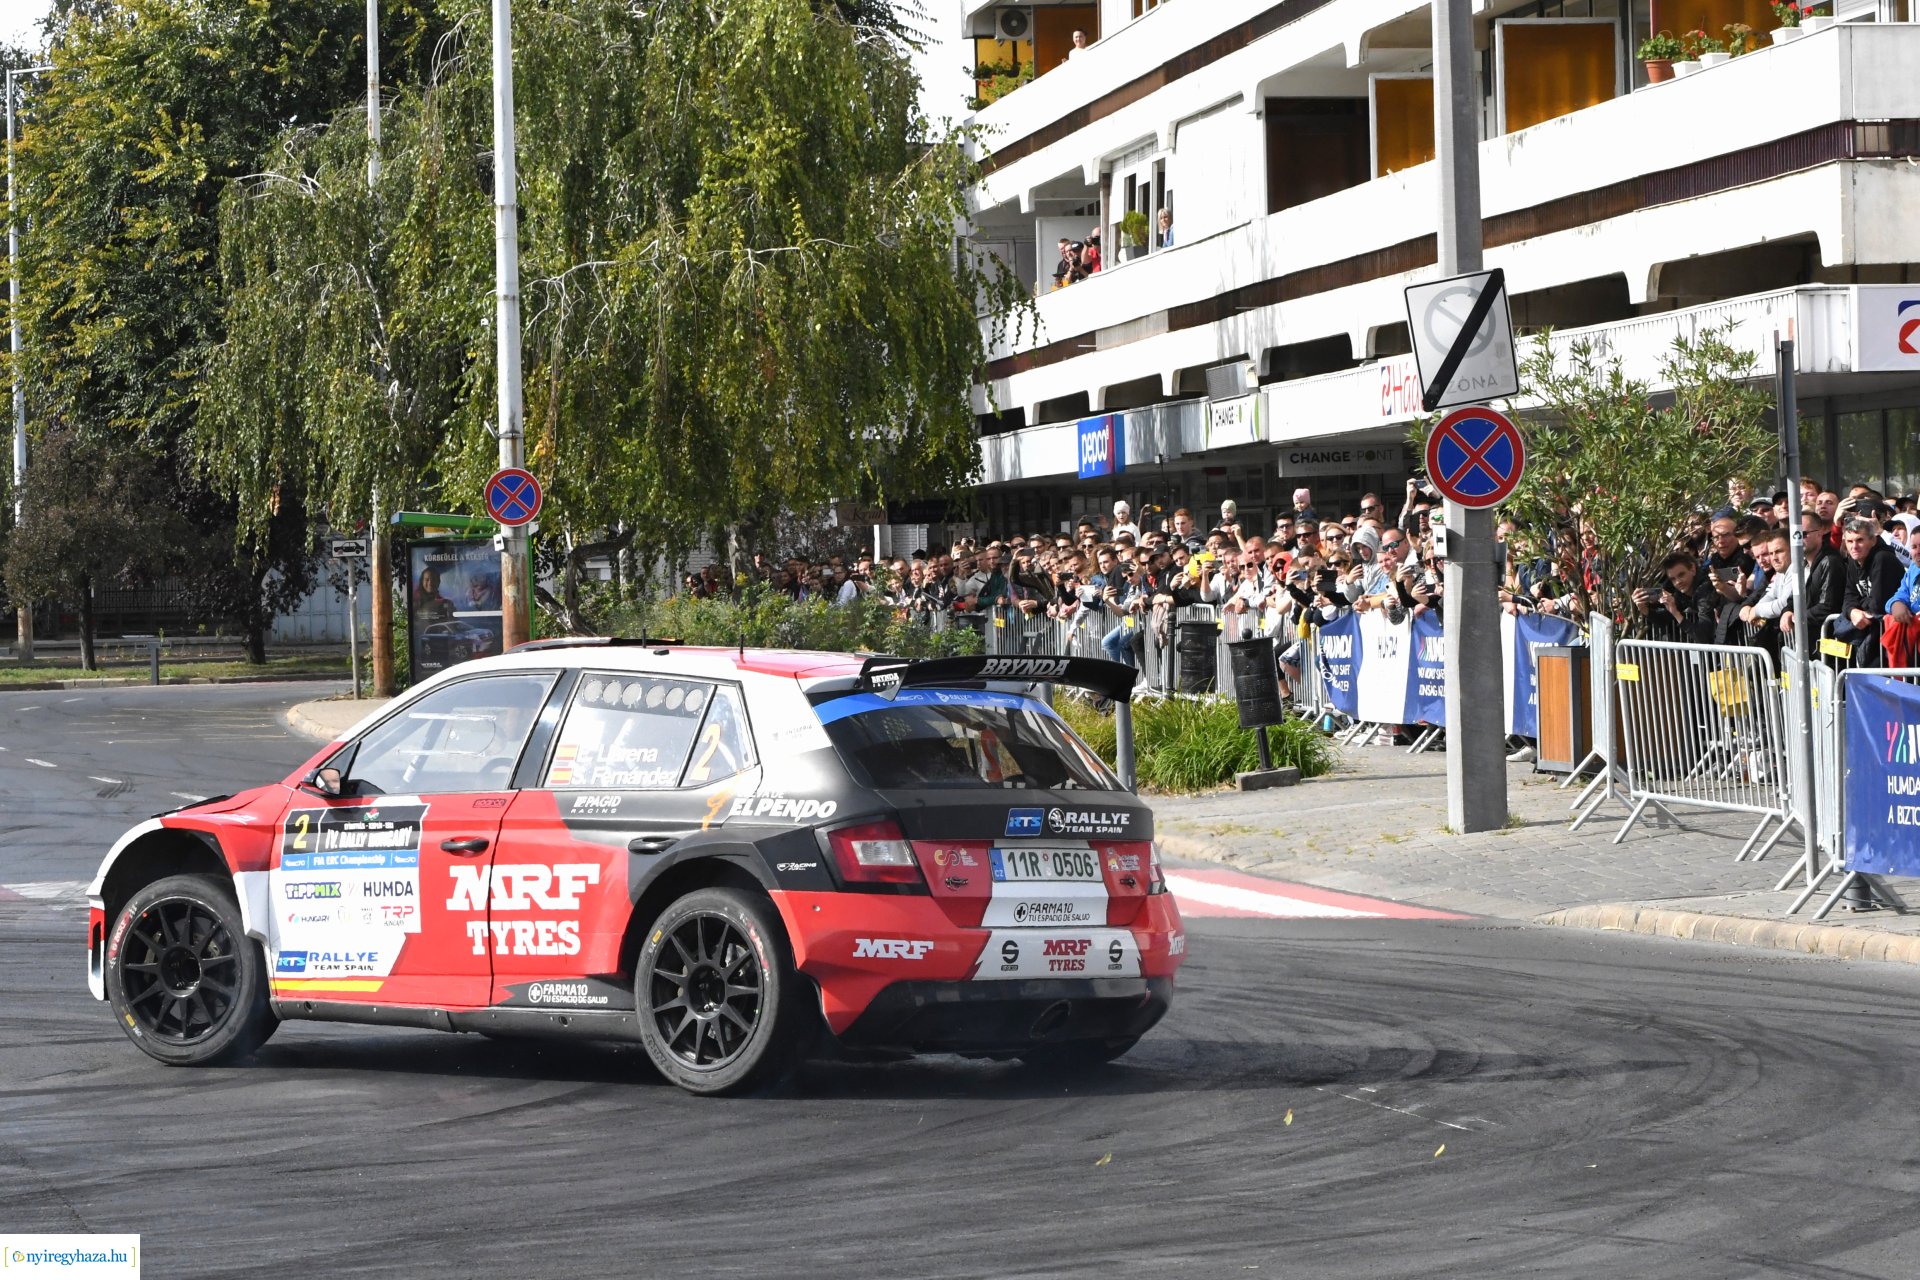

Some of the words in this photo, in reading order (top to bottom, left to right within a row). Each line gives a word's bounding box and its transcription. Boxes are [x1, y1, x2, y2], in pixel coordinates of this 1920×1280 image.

[1081, 429, 1108, 472] pepco
[977, 658, 1070, 676] BRYNDA
[871, 672, 899, 684] BRYNDA
[690, 723, 721, 781] 2
[592, 766, 678, 786] Fernández
[585, 796, 621, 808] PAGID
[728, 798, 755, 816] EL
[754, 799, 838, 823] PENDO
[1066, 811, 1130, 825] RALLYE
[1887, 804, 1895, 824] A
[1008, 816, 1042, 828] RTS
[1066, 825, 1093, 833] TEAM
[1096, 826, 1123, 834] SPAIN
[293, 814, 310, 849] 2
[339, 831, 368, 848] RALLY
[367, 825, 413, 848] HUNGARY
[340, 853, 386, 867] Championship
[1007, 851, 1042, 878] 11R
[1053, 851, 1095, 878] 0506
[994, 869, 1004, 878] CZ
[363, 880, 414, 898] HUMDA
[446, 863, 601, 911] MRF
[380, 905, 415, 919] TRP
[1028, 902, 1074, 914] FARMA10
[1028, 914, 1037, 922] TU
[1037, 913, 1062, 922] ESPACIO
[1063, 913, 1072, 921] DE
[1072, 913, 1090, 921] SALUD
[466, 920, 581, 956] TYRES
[853, 938, 934, 960] MRF
[1042, 939, 1092, 956] MRF
[309, 952, 379, 962] RALLYE
[1048, 959, 1086, 972] TYRES
[543, 983, 588, 996] FARMA10
[543, 995, 551, 1003] TU
[552, 995, 578, 1004] ESPACIO
[578, 996, 587, 1004] DE
[587, 996, 608, 1004] SALUD
